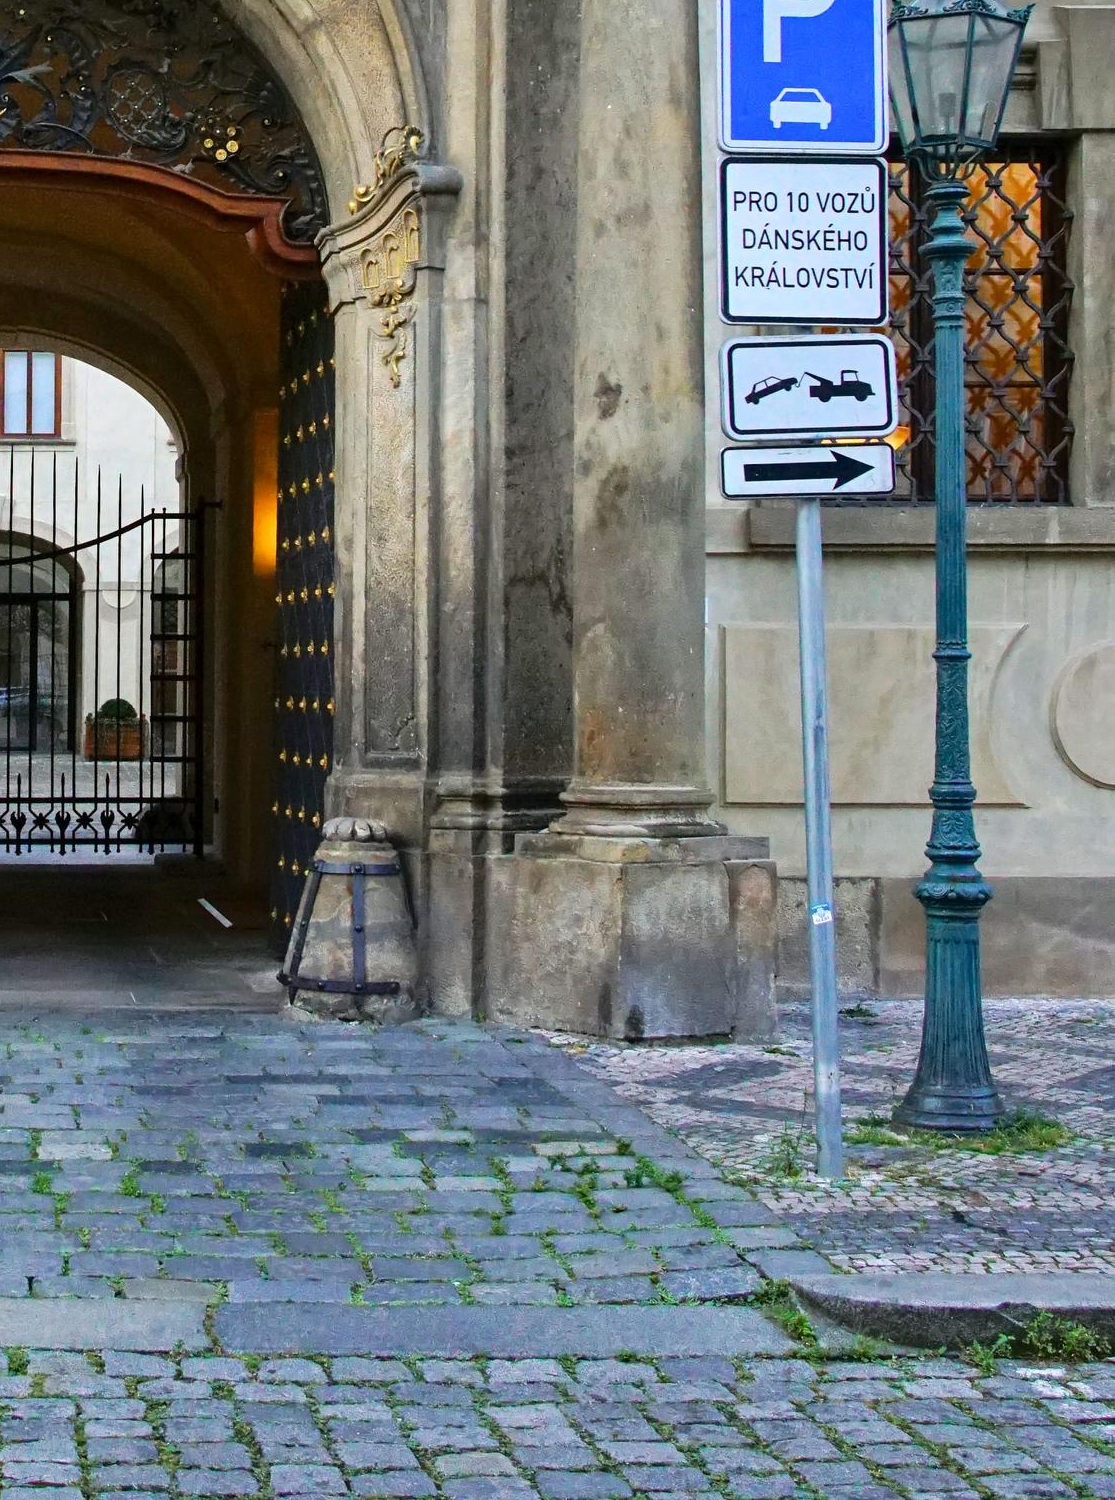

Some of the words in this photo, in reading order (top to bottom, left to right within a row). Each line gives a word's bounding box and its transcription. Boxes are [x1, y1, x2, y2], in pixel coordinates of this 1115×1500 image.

[733, 191, 778, 212] PRO
[787, 192, 809, 213] 10
[816, 186, 875, 214] VOZŮ
[742, 223, 868, 251] DÁNSKÉHO
[735, 261, 875, 289] KRÁLOVSTVÍ
